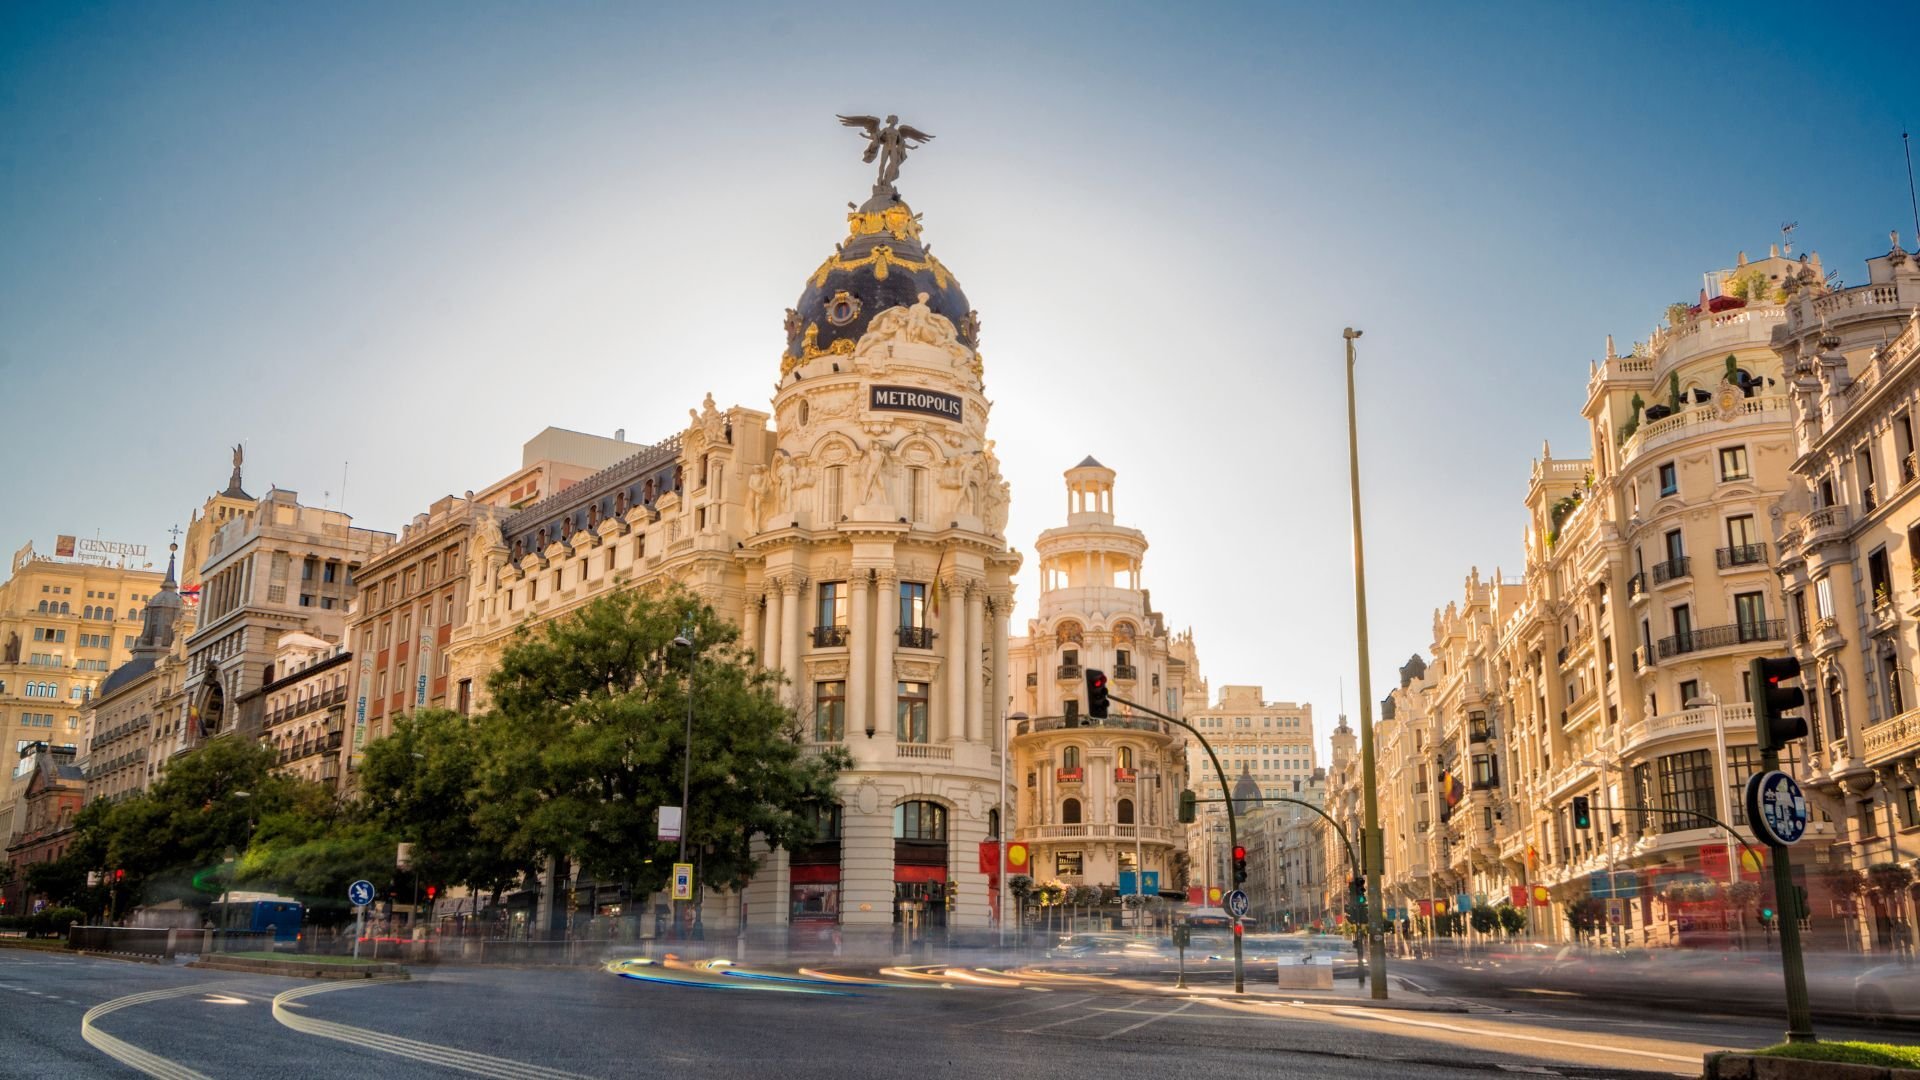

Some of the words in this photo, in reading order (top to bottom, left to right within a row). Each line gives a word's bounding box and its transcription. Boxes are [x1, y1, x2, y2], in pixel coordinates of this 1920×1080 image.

[876, 391, 960, 415] METROPOLIS
[79, 539, 147, 557] GENERALI
[417, 675, 427, 705] salida
[357, 697, 367, 724] salida
